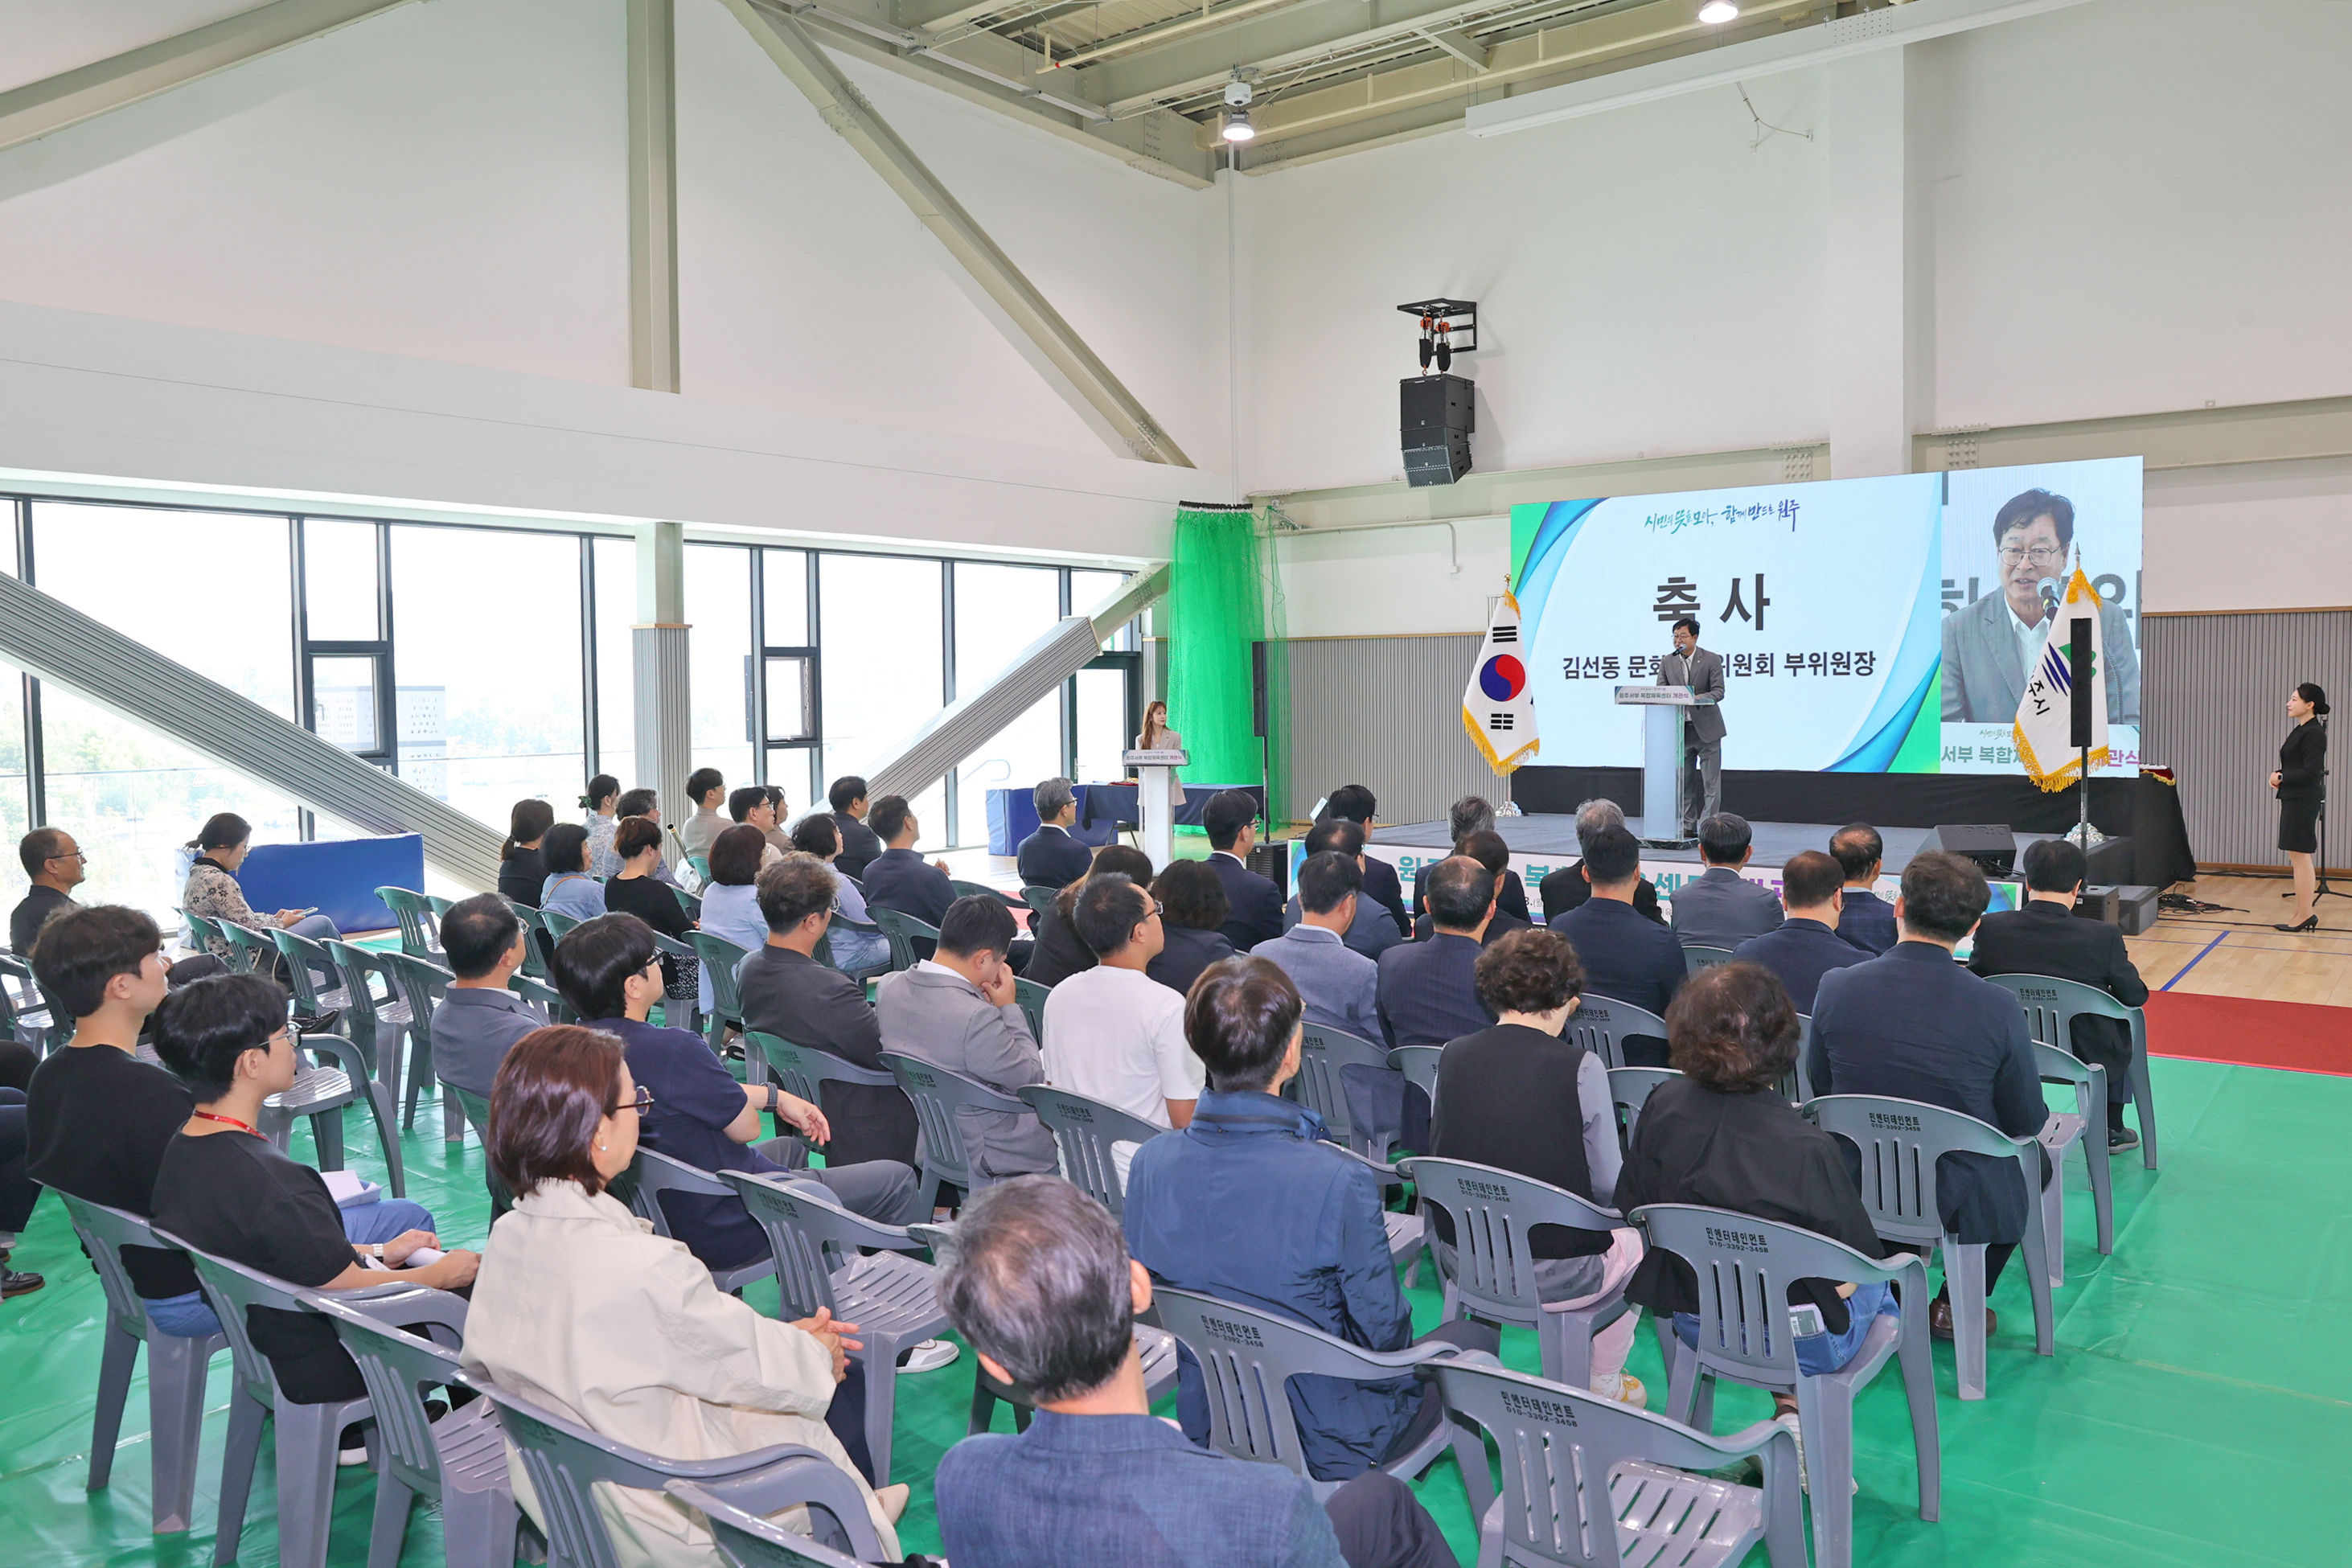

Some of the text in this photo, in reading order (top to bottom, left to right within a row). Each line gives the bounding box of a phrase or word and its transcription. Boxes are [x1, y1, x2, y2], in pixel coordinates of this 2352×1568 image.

[1644, 512, 1673, 532] 시민의
[1671, 509, 1693, 534] 뜻을
[1721, 504, 1747, 524] 함께
[1747, 502, 1775, 521] 만드는
[1778, 499, 1800, 532] 원주
[1562, 656, 1620, 679] 김선동
[1783, 651, 1876, 678] 부위원장
[2029, 677, 2050, 716] 주시
[1941, 746, 1973, 763] 서부
[1869, 1112, 1919, 1126] 민엔터테인먼트
[1457, 1178, 1508, 1196] 민엔터테인먼트
[1706, 1227, 1767, 1246] 민엔터테인먼트
[1709, 1240, 1769, 1253] 010-3392-3458
[1201, 1315, 1262, 1339] 민엔터테인먼트
[1500, 1391, 1574, 1418] 민엔터테인먼트
[1506, 1406, 1578, 1427] 010-3392-3458
